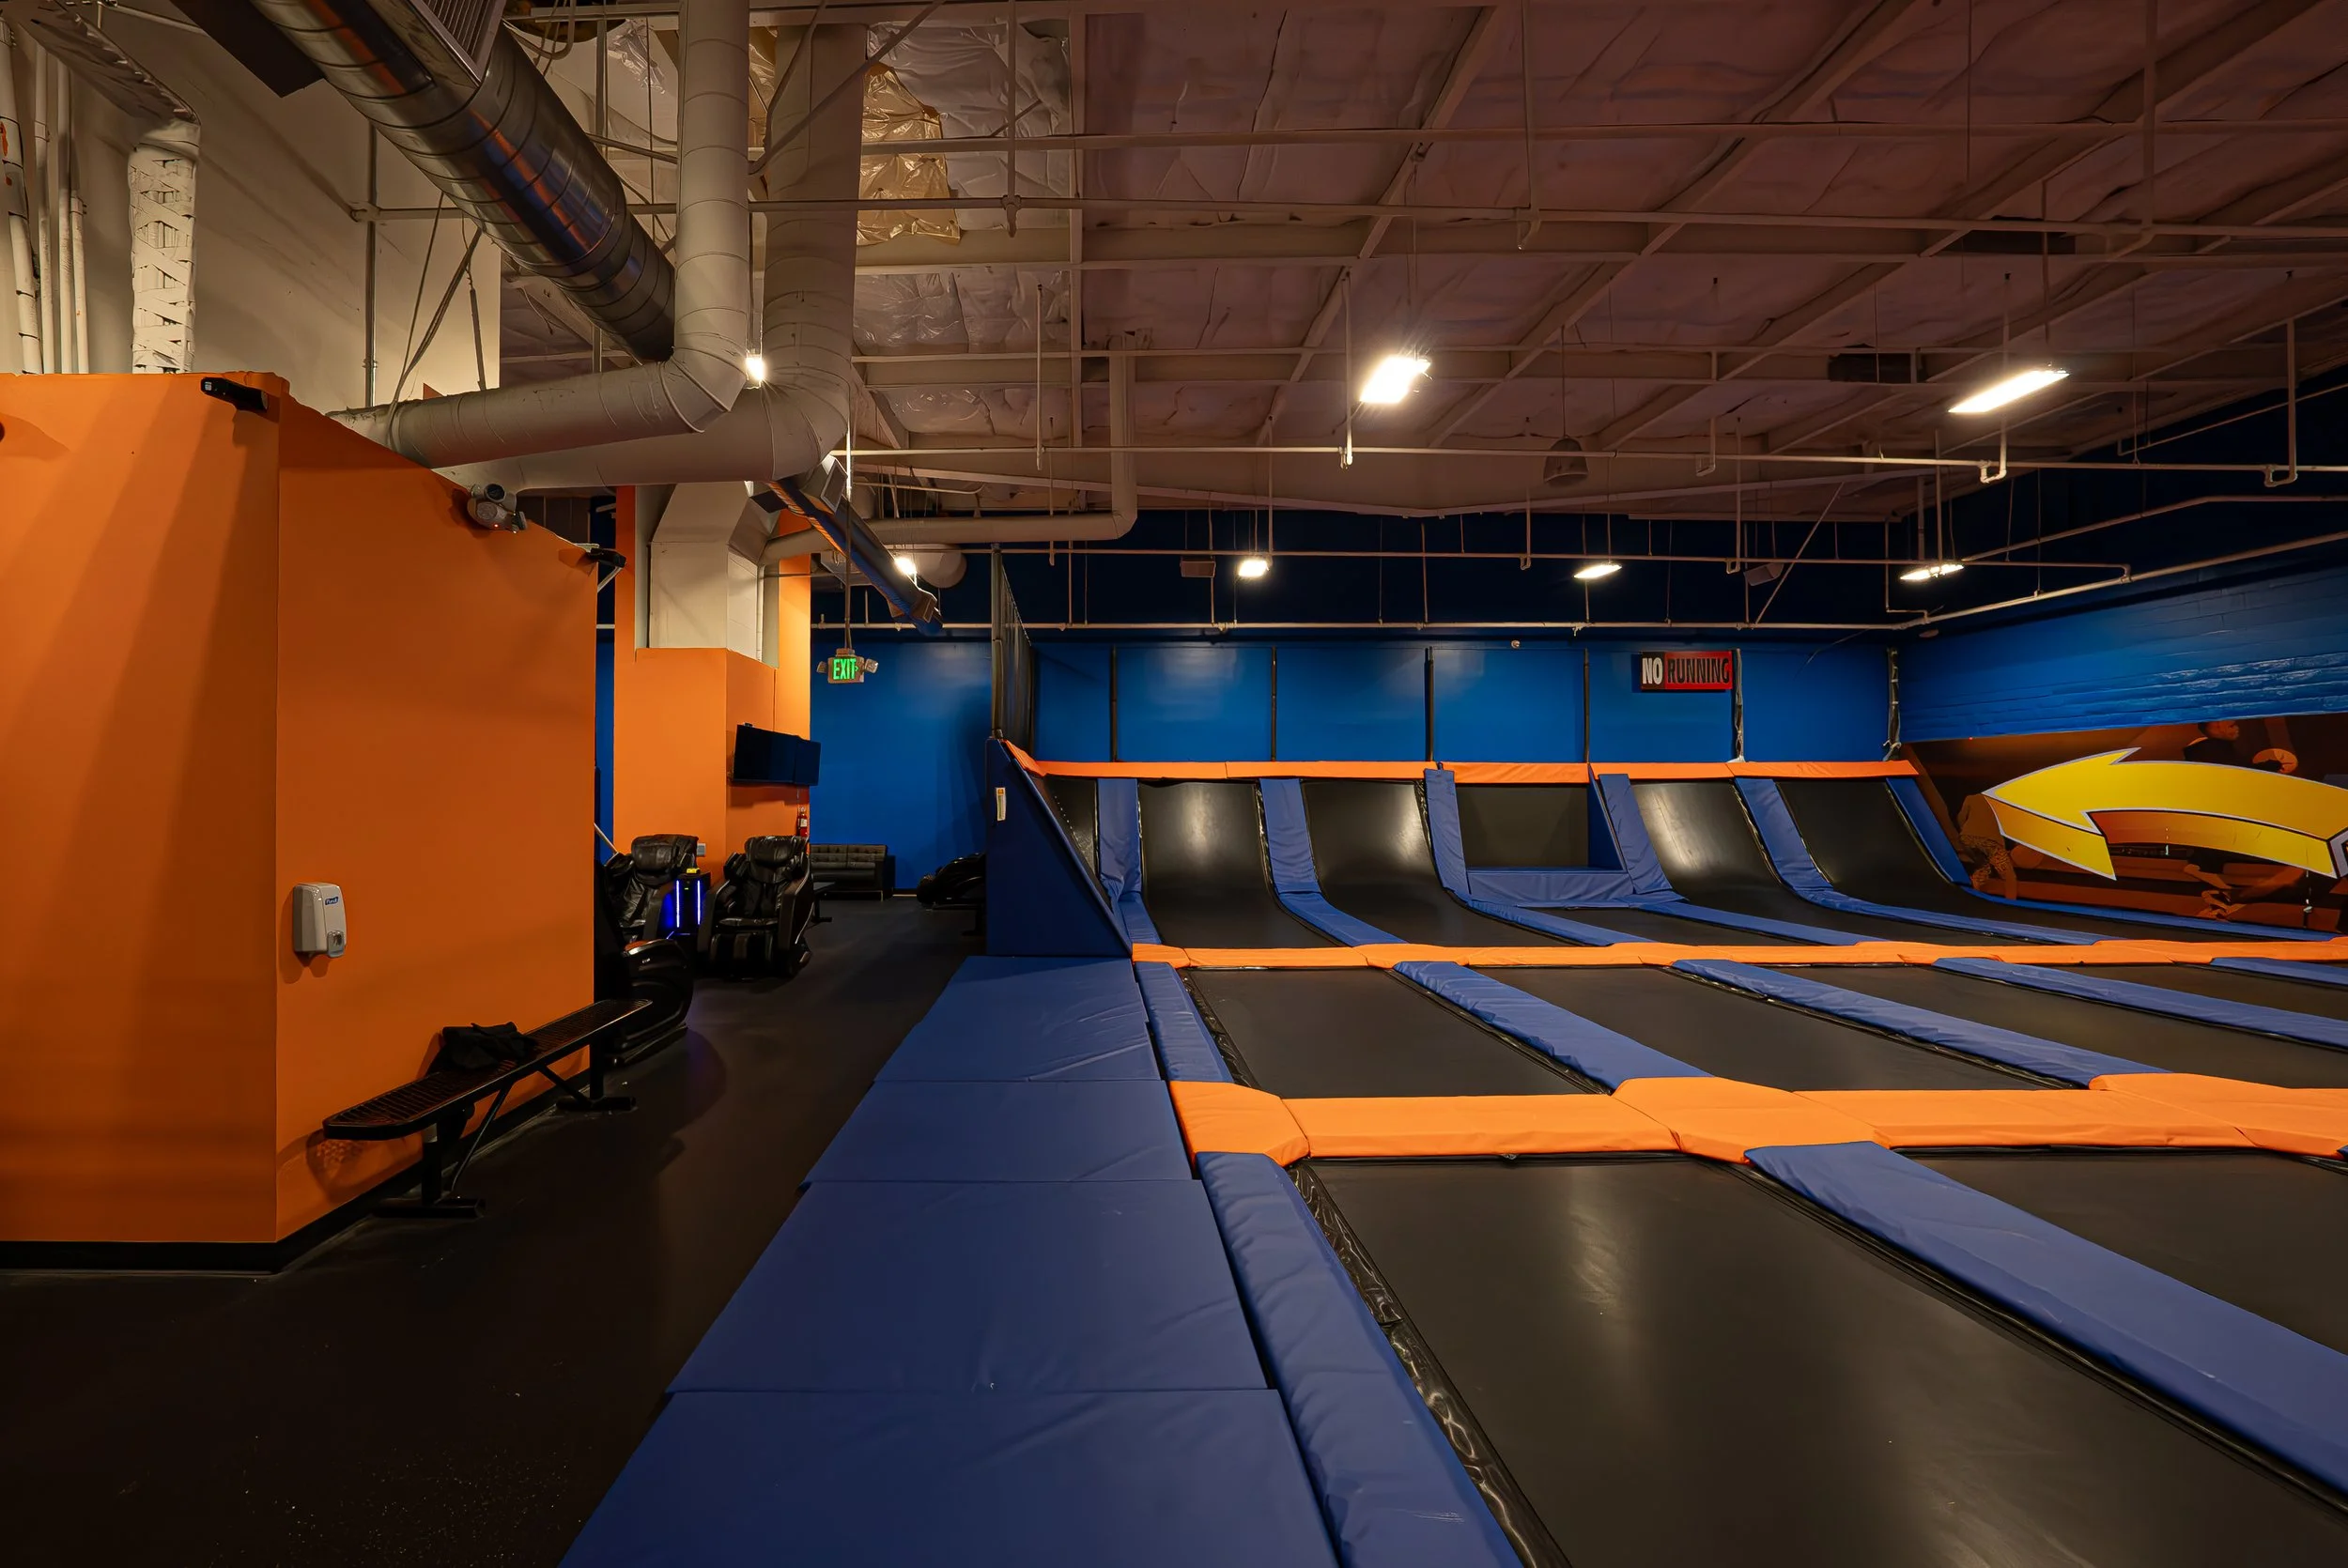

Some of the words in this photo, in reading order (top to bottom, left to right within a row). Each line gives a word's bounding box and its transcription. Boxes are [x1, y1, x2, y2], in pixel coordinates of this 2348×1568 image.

[833, 658, 857, 680] EXIT
[1642, 657, 1663, 684] NO
[1667, 658, 1730, 684] RUNNING
